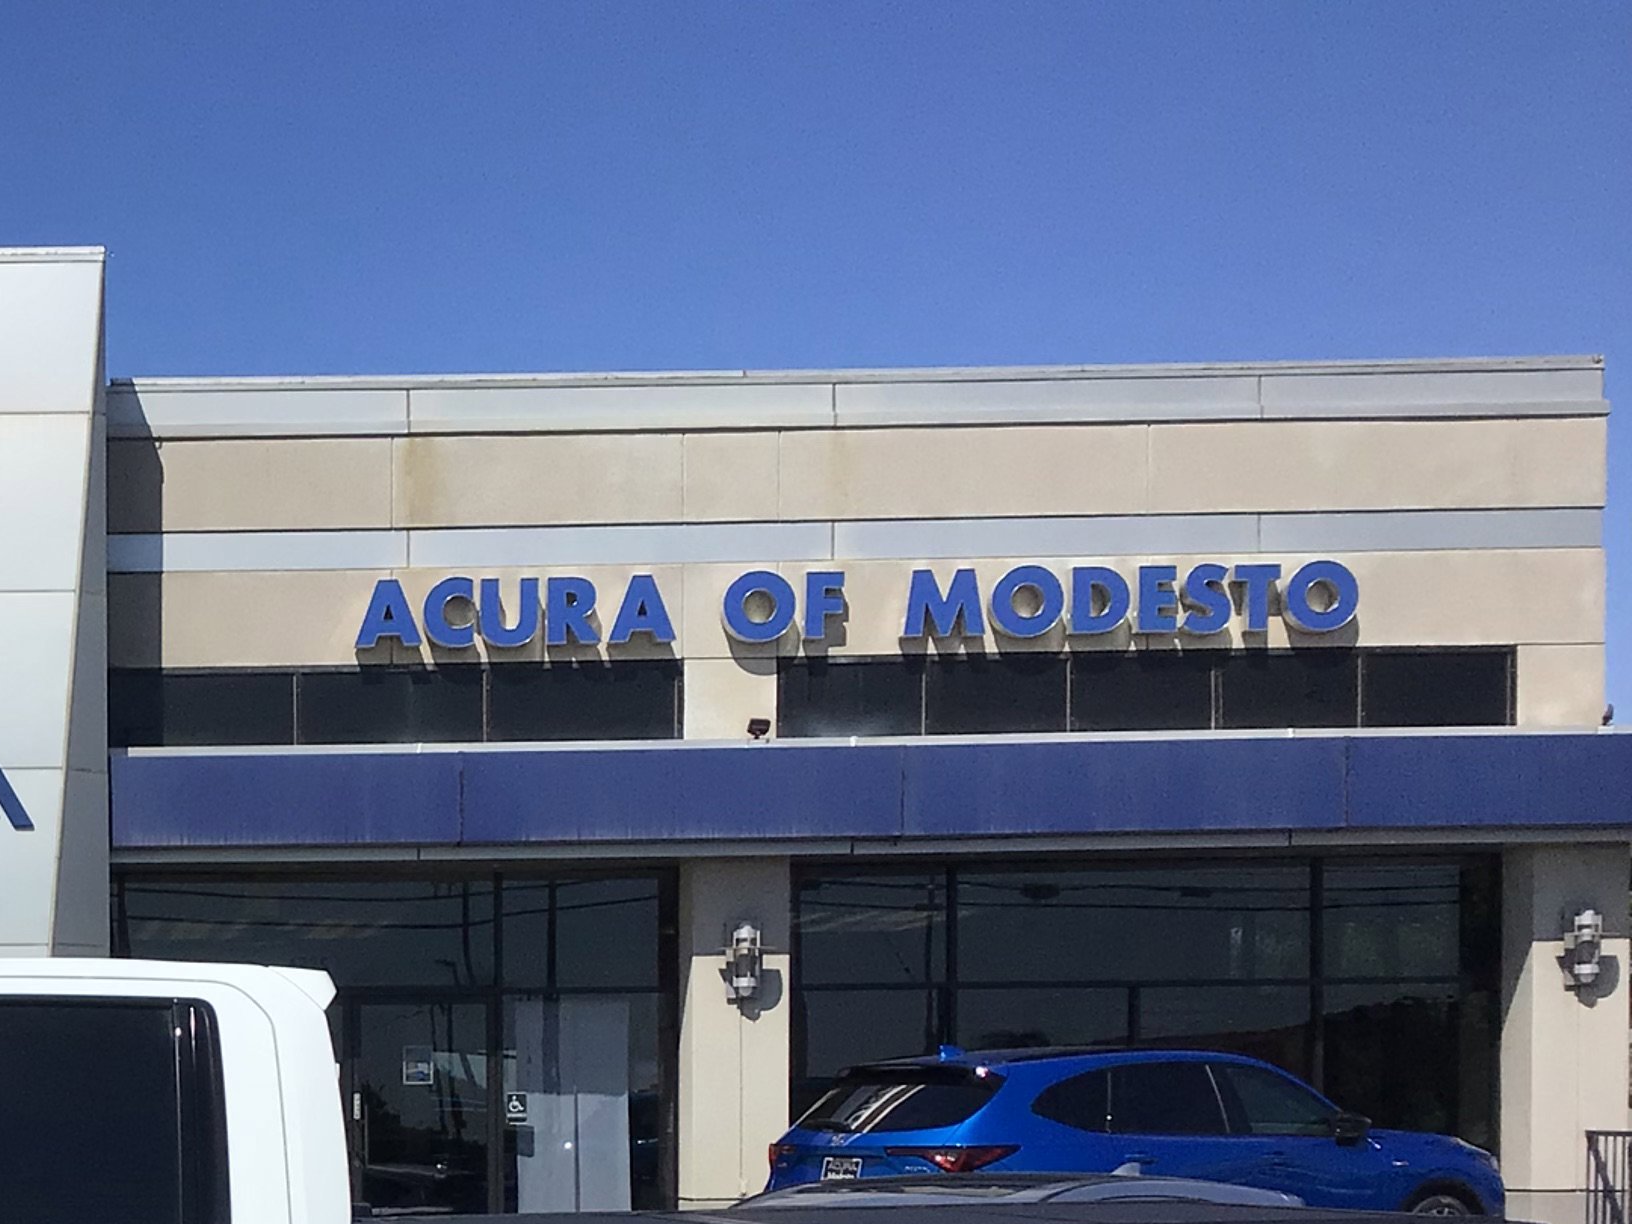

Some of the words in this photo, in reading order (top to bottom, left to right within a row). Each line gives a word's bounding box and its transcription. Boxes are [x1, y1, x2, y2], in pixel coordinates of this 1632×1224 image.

[357, 576, 674, 648] ACURA
[722, 571, 845, 642] OF
[904, 560, 1359, 638] MODESTO
